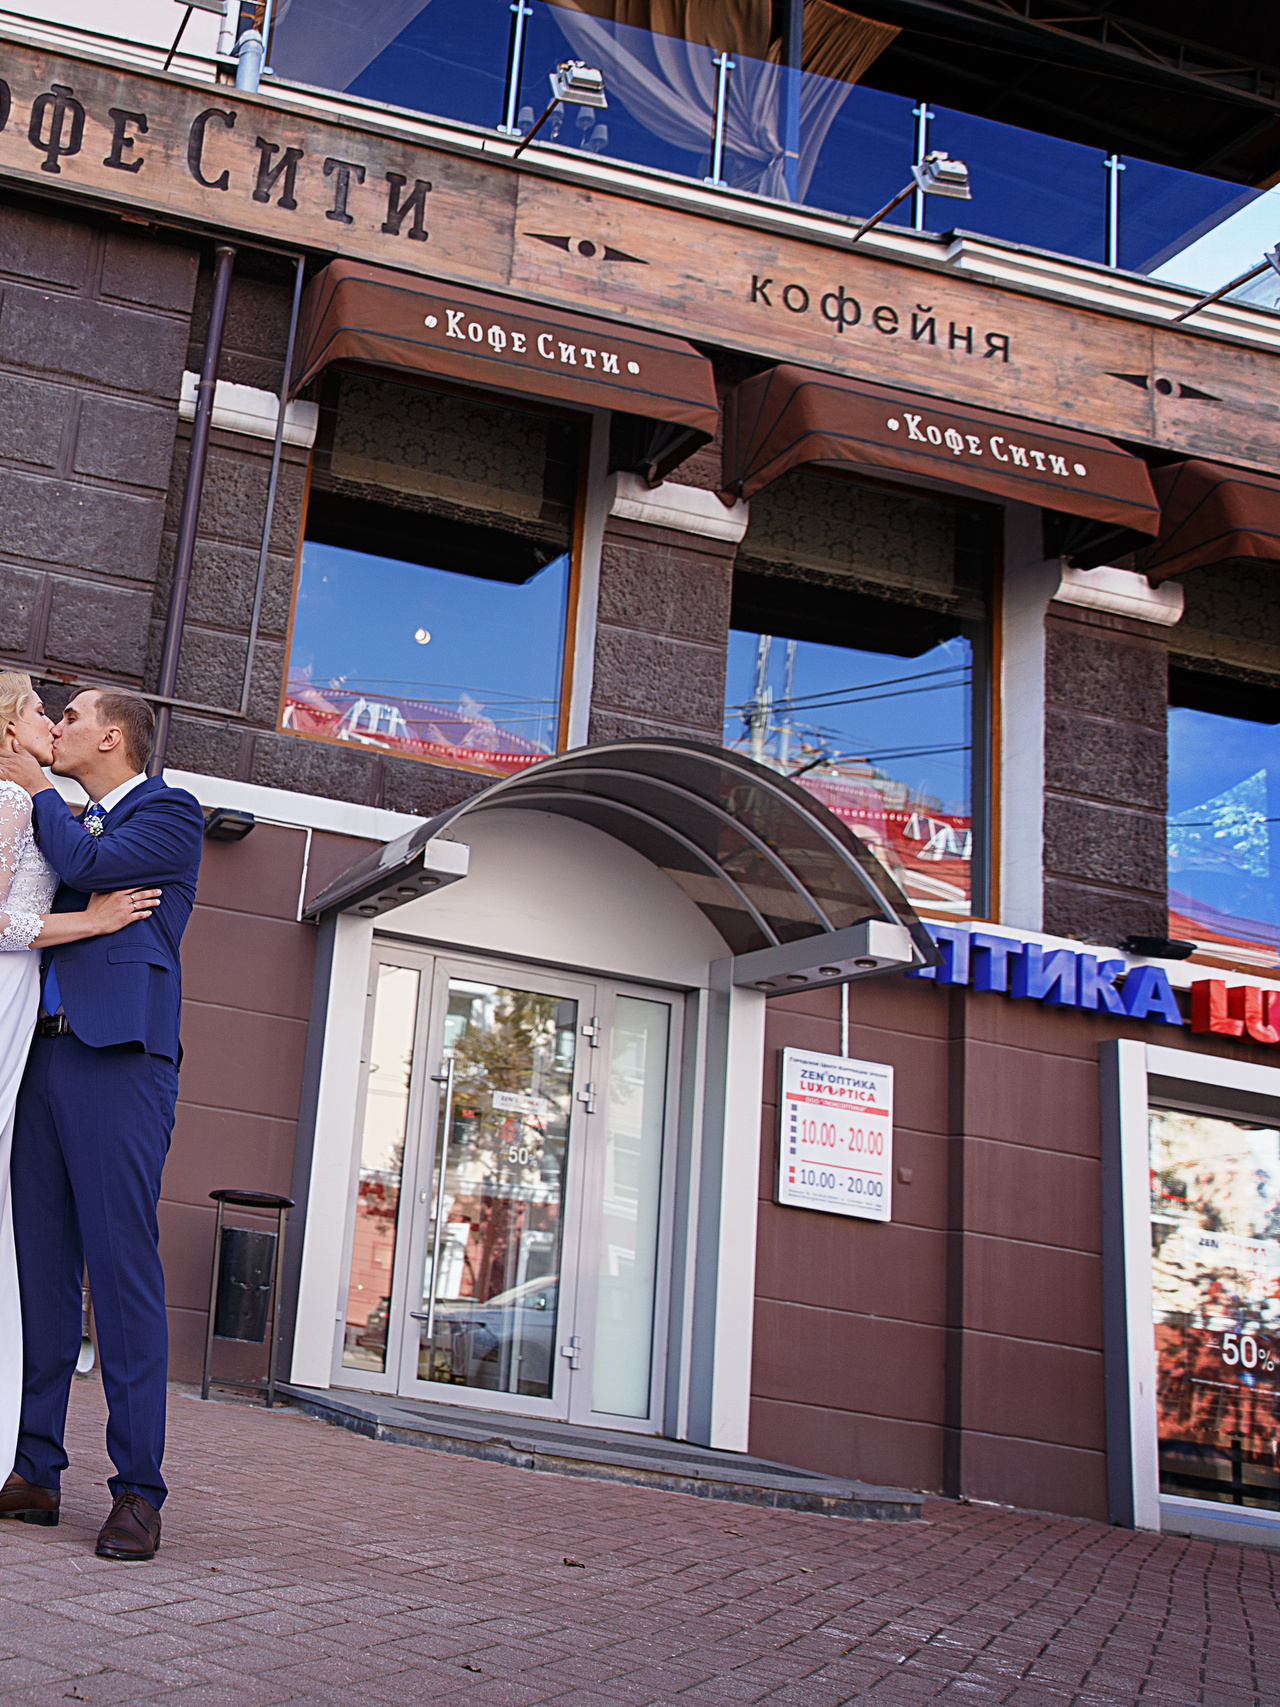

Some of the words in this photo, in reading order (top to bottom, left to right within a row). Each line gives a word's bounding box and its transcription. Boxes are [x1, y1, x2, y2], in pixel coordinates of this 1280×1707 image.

[751, 275, 1011, 363] кофейня
[904, 922, 1183, 1026] ПТИКА
[801, 1119, 837, 1148] 10.00
[848, 1127, 884, 1156] 20.00
[801, 1168, 836, 1189] 10.00
[847, 1176, 883, 1198] 20.00
